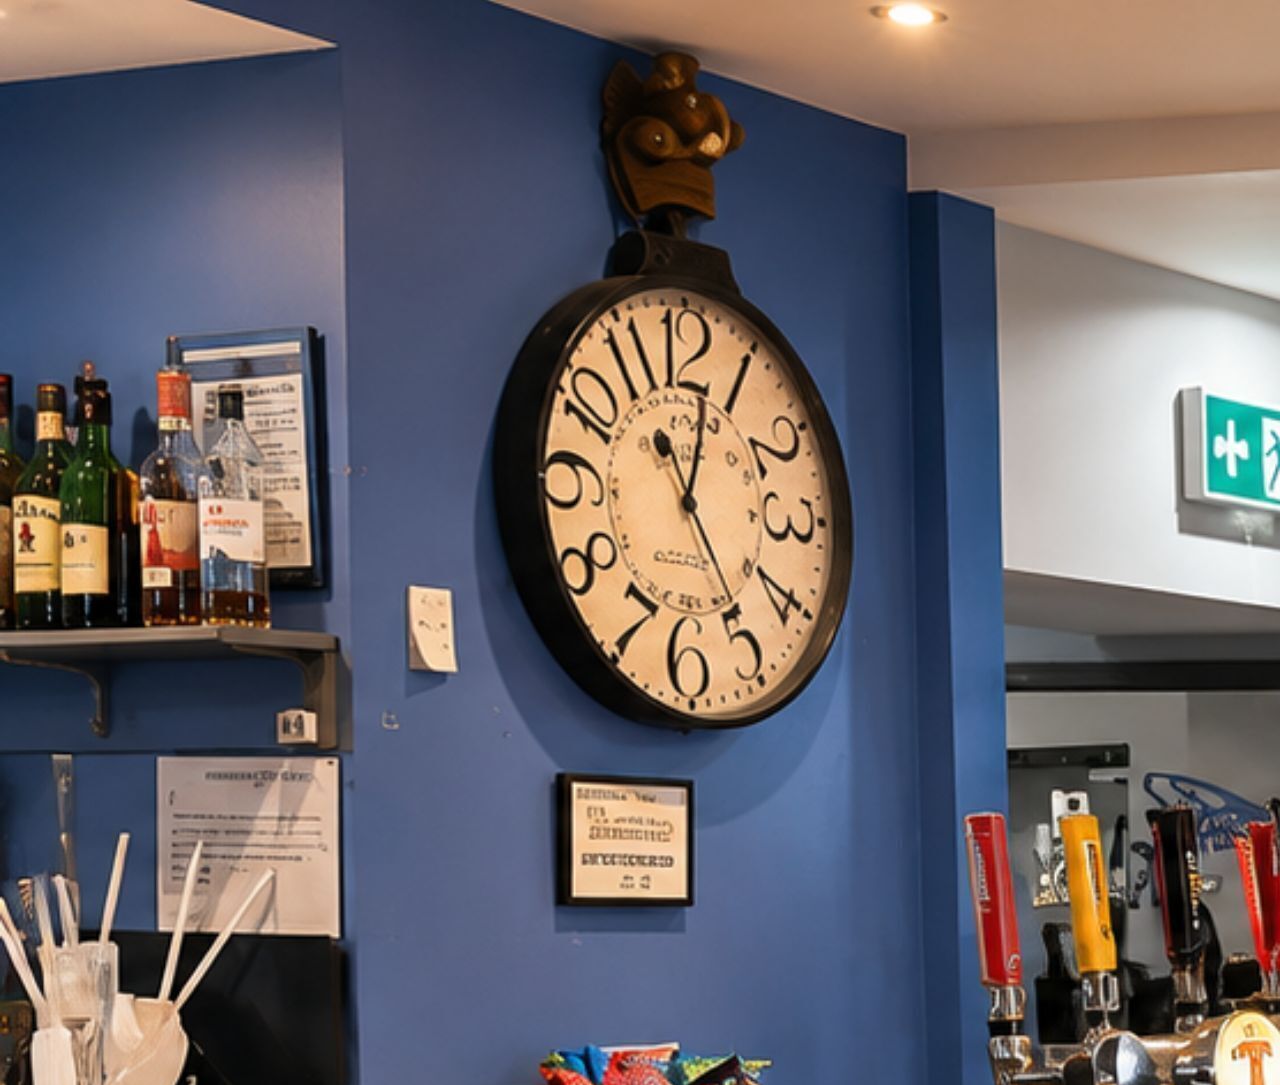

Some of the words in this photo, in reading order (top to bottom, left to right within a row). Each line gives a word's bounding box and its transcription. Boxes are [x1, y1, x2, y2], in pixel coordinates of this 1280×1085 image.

[604, 316, 659, 402] 11
[661, 307, 712, 397] 12
[723, 353, 752, 415] 1
[564, 366, 619, 445] 10
[544, 449, 604, 510] 9
[748, 415, 800, 481] 2
[763, 491, 814, 546] 3
[560, 531, 618, 597] 8
[756, 564, 802, 626] 4
[614, 581, 660, 657] 7
[721, 601, 762, 682] 5
[666, 615, 710, 699] 6
